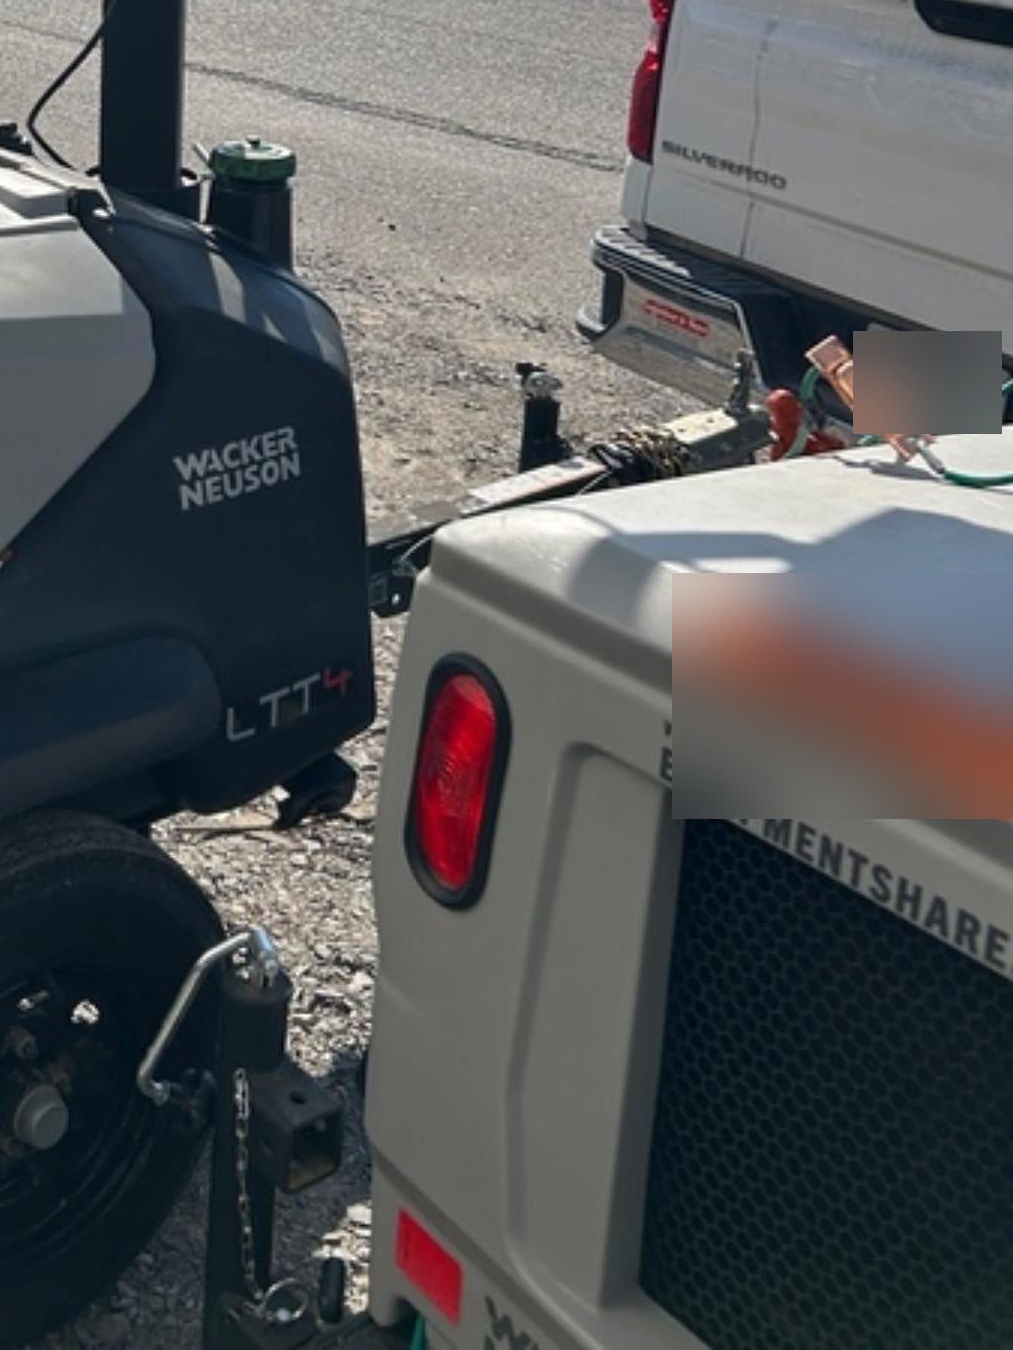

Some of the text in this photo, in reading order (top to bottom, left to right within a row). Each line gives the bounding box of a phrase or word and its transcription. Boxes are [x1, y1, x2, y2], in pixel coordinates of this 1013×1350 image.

[661, 140, 787, 190] SILVERADO
[172, 425, 298, 482] WACKER
[178, 452, 301, 511] NEUSON
